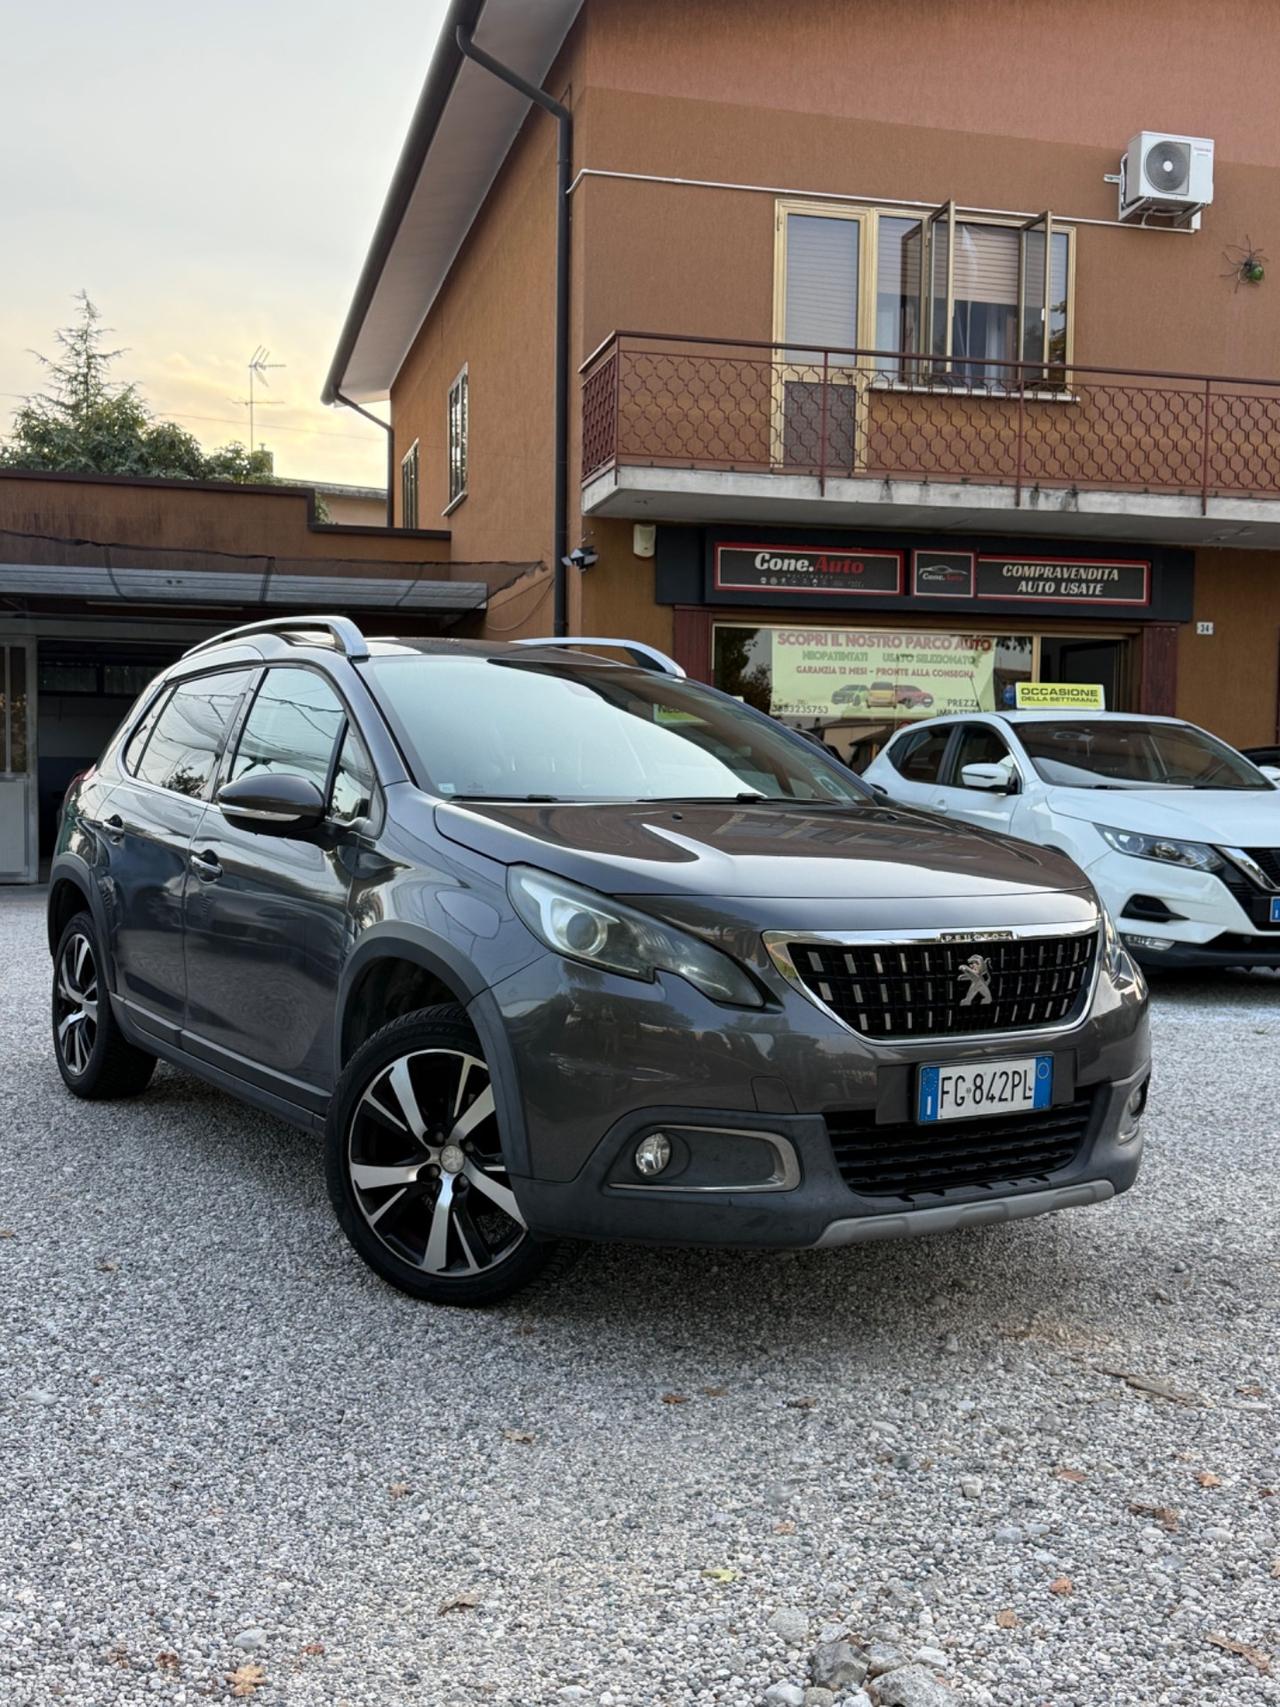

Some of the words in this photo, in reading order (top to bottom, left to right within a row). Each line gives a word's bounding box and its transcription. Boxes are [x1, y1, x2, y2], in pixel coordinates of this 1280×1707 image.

[754, 552, 864, 575] Cone.Auto
[1002, 564, 1119, 581] COMPRAVENDITA
[1017, 580, 1056, 594] AUTO
[1060, 582, 1104, 595] USATE
[777, 632, 828, 647] SCOPRI
[831, 633, 842, 647] IL
[846, 633, 902, 649] NOSTRO
[906, 636, 952, 650] PARCO
[954, 637, 992, 652] AUTO
[882, 653, 914, 663] USATO
[796, 666, 837, 675] GARANZIA
[849, 667, 867, 676] MESI
[876, 668, 908, 677] PRONTE
[911, 669, 930, 677] ALLA
[932, 669, 975, 679] CONSEGNA
[1021, 687, 1098, 697] OCCASIONE
[945, 932, 1007, 942] PEUGEOT
[940, 1074, 966, 1110] FG
[972, 1069, 1033, 1106] 842PL
